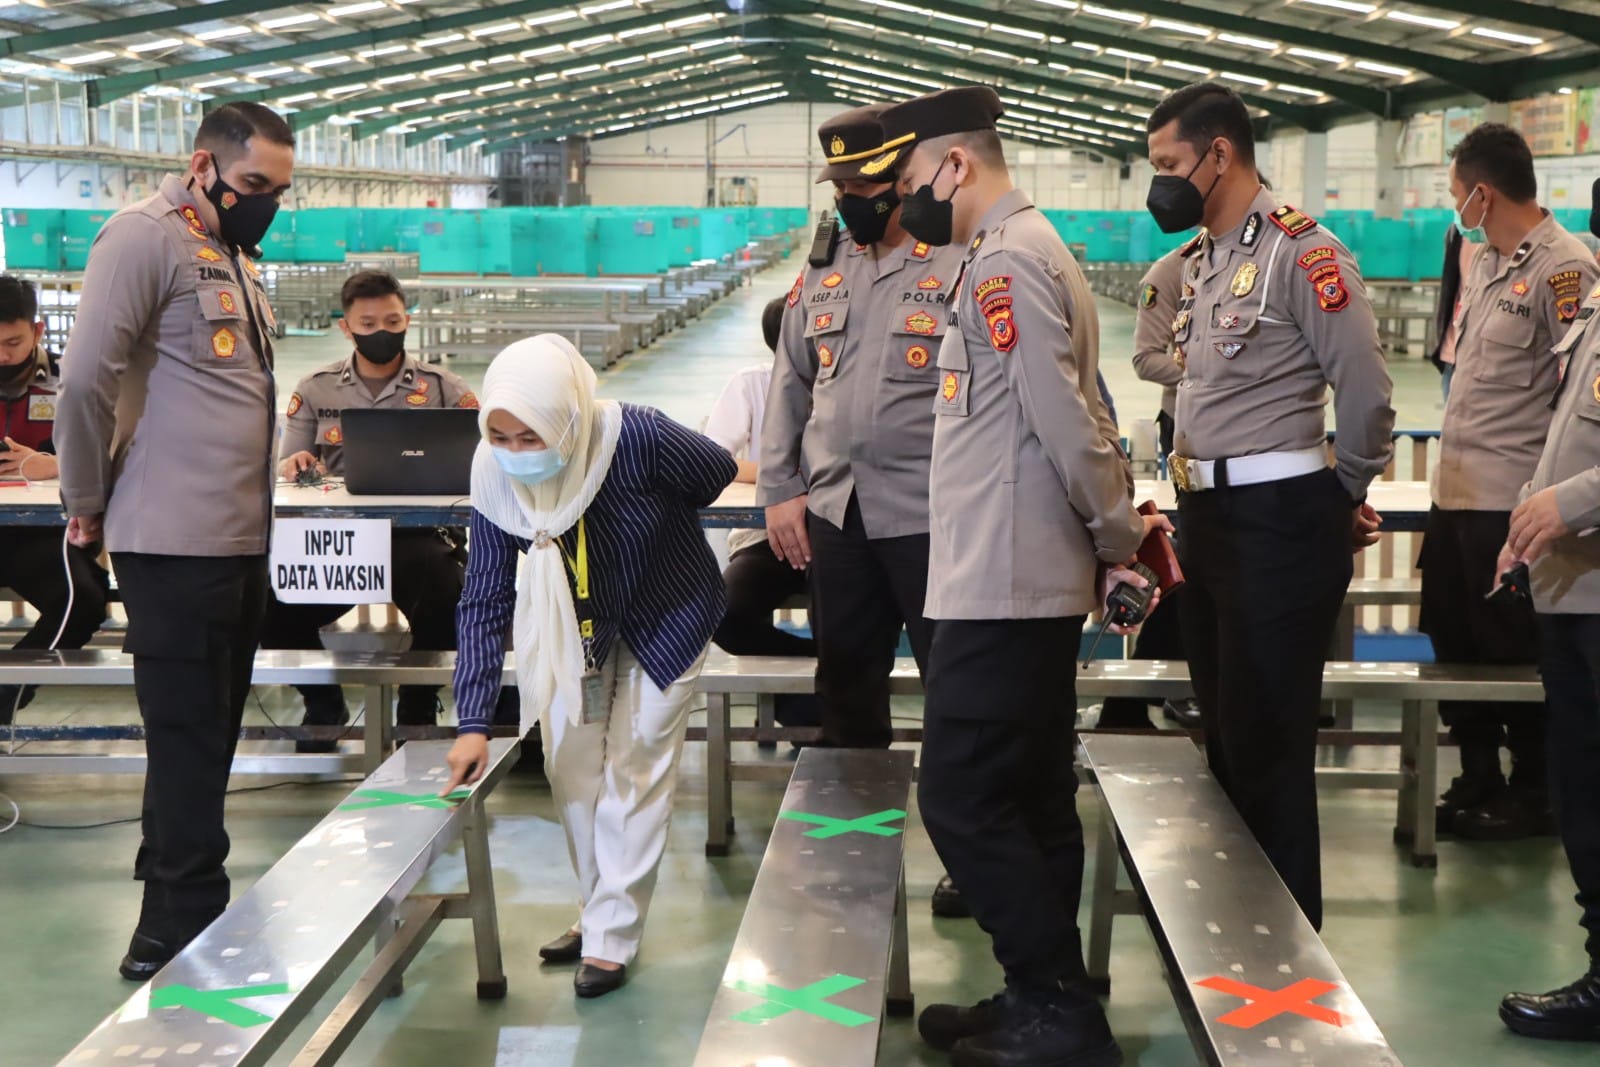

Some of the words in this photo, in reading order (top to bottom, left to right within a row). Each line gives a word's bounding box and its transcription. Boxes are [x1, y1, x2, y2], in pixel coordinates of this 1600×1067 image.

[1550, 272, 1578, 284] POLRES
[977, 278, 1003, 294] POLRES
[811, 292, 831, 303] ASEP
[903, 292, 945, 304] POLR
[1497, 299, 1530, 318] POLRI
[318, 408, 342, 418] ROB
[305, 530, 355, 556] INPUT
[277, 564, 319, 590] DATA
[323, 565, 385, 591] VAKSIN
